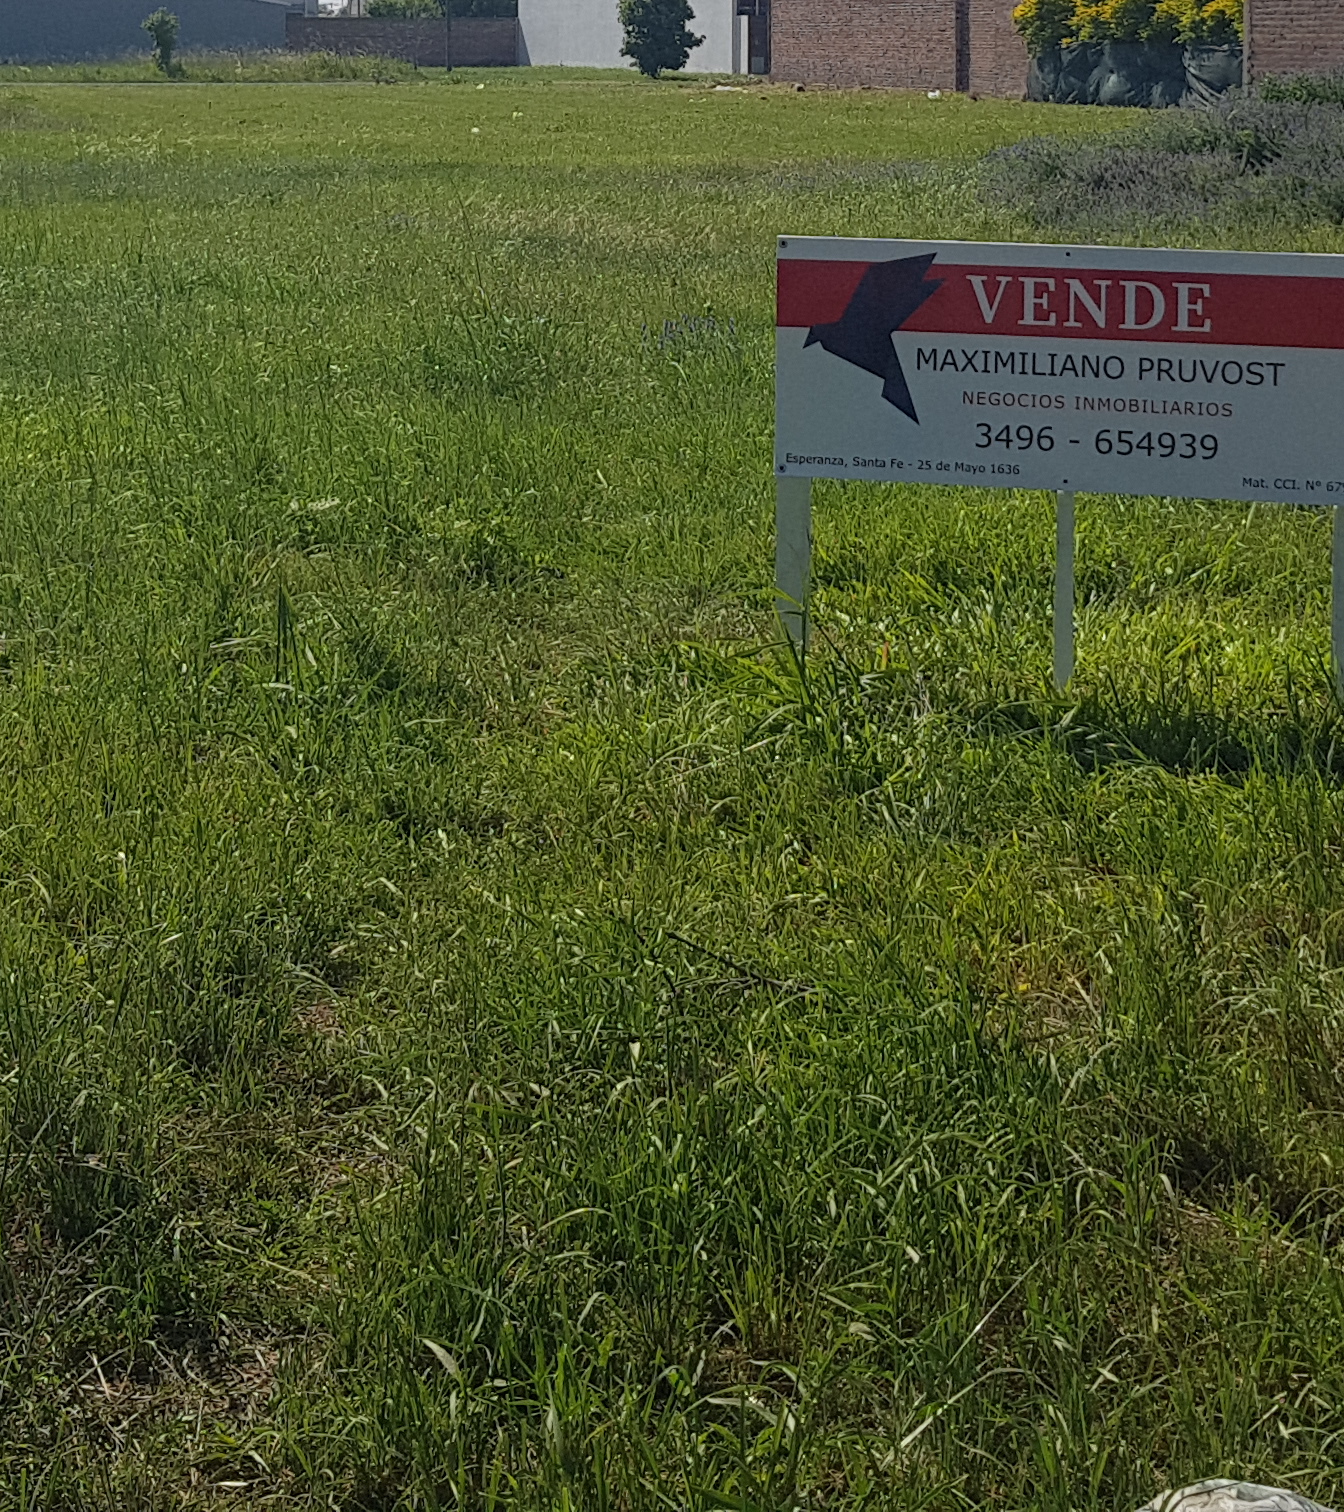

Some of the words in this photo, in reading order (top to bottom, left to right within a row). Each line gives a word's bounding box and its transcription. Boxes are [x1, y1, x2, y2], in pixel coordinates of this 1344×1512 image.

[966, 274, 1212, 333] VENDE
[916, 347, 1125, 381] MAXIMILIANO
[1138, 356, 1285, 387] PRUVOST
[962, 391, 1066, 410] NEGOCIOS
[1075, 396, 1234, 418] INMOBILIARIOS
[974, 423, 1055, 452] 3496
[1094, 429, 1219, 460] 654939
[785, 453, 848, 468] Esperanza,
[852, 456, 886, 468] Santa
[890, 458, 904, 469] Fe
[917, 460, 932, 471] 25
[936, 460, 951, 472] de
[955, 462, 986, 475] Mayo
[990, 463, 1020, 475] 1636
[1242, 477, 1268, 489] Mat.
[1273, 478, 1300, 490] CCI.
